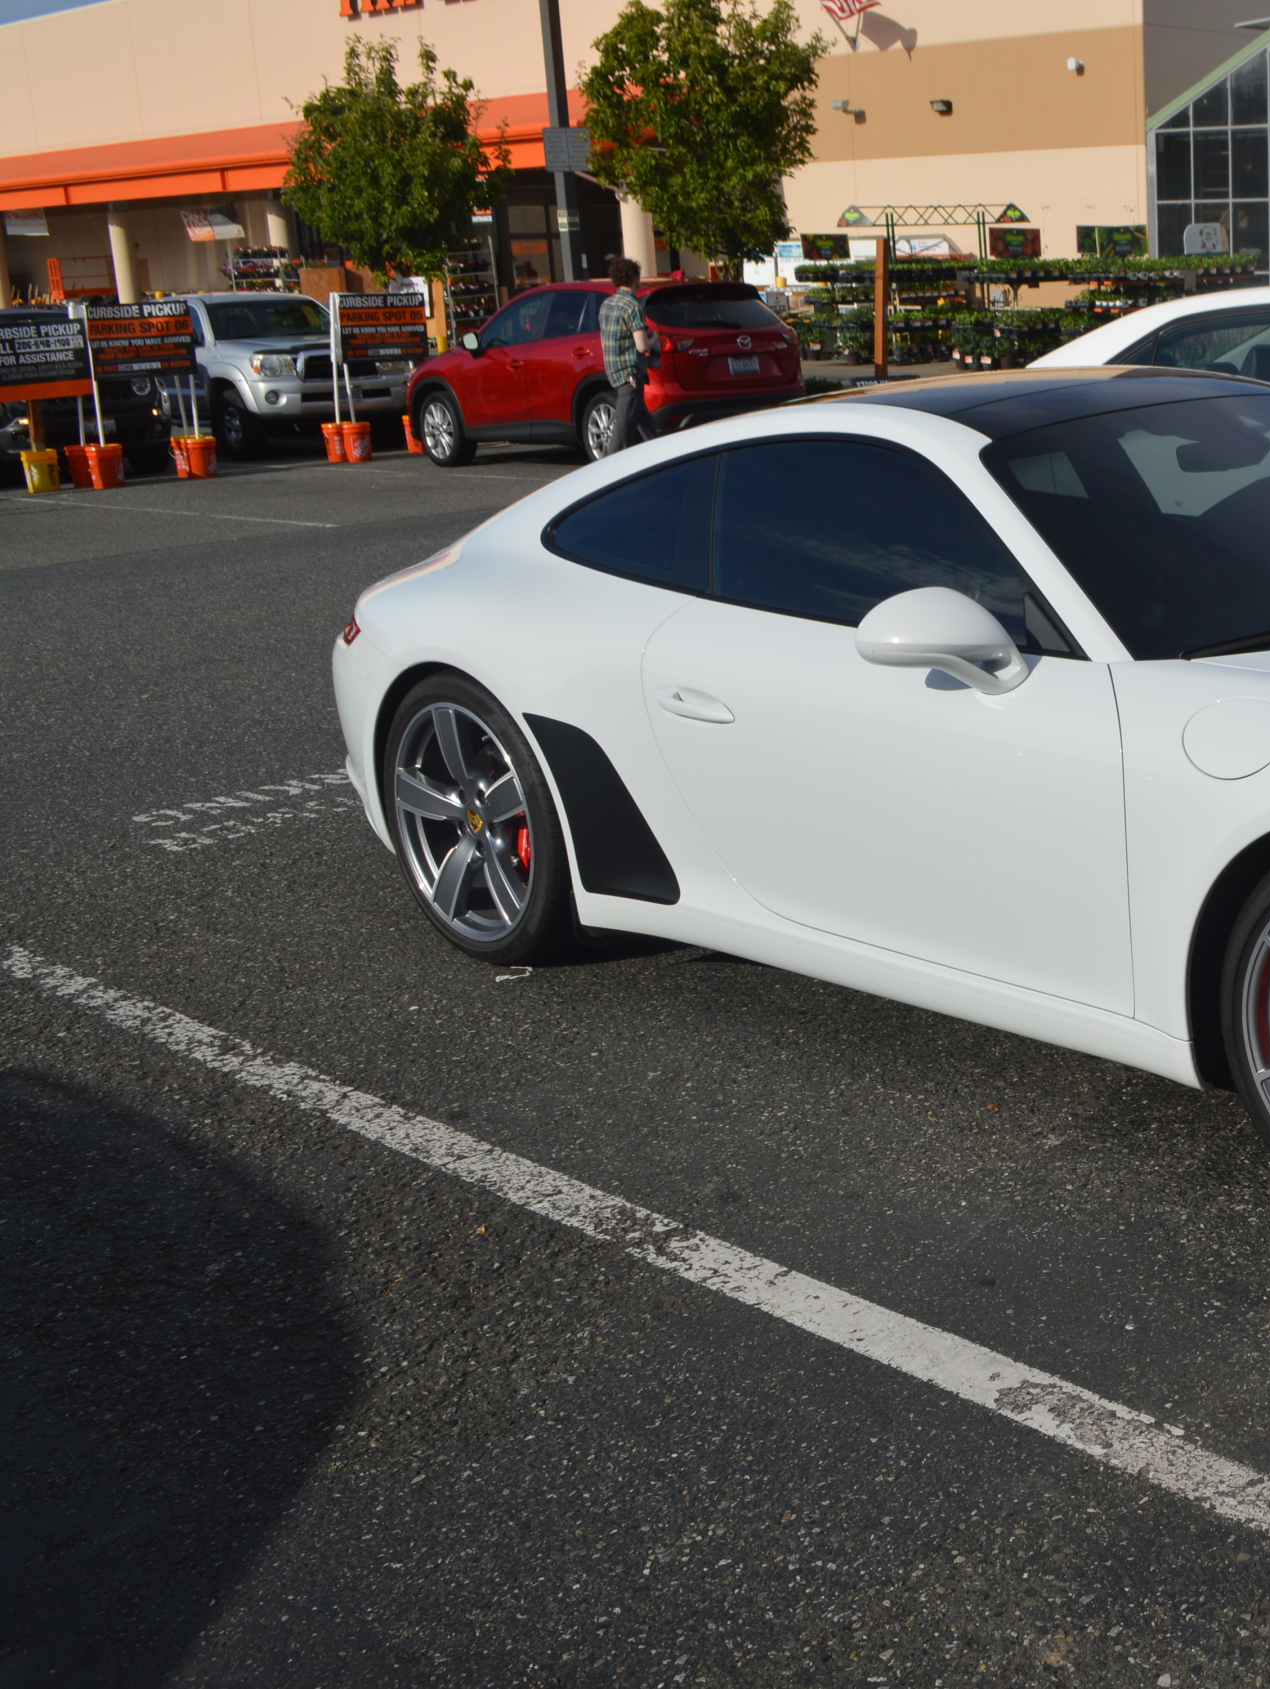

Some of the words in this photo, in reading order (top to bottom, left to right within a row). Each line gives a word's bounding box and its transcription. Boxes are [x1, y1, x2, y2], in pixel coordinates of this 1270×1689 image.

[339, 296, 385, 308] CURBSIDE
[387, 294, 422, 307] PICKUP
[87, 305, 140, 319] CURBSIDE
[142, 303, 187, 317] PICKUP
[340, 312, 380, 323] PARKING
[382, 310, 407, 322] SPOT
[409, 310, 423, 321] 05
[0, 326, 38, 340] RBSIDE
[40, 323, 81, 337] PICKUP
[89, 322, 136, 336] PARKING
[139, 320, 171, 334] SPOT
[174, 319, 190, 331] 06
[342, 327, 352, 335] LET
[352, 326, 360, 334] US
[376, 325, 387, 333] YOU
[91, 340, 100, 349] LET
[100, 339, 108, 348] US
[108, 338, 130, 347] KNOW
[130, 337, 145, 346] YOU
[145, 336, 162, 345] HAVE
[163, 335, 192, 344] ARRIVED
[18, 351, 75, 364] ASSISTANCE
